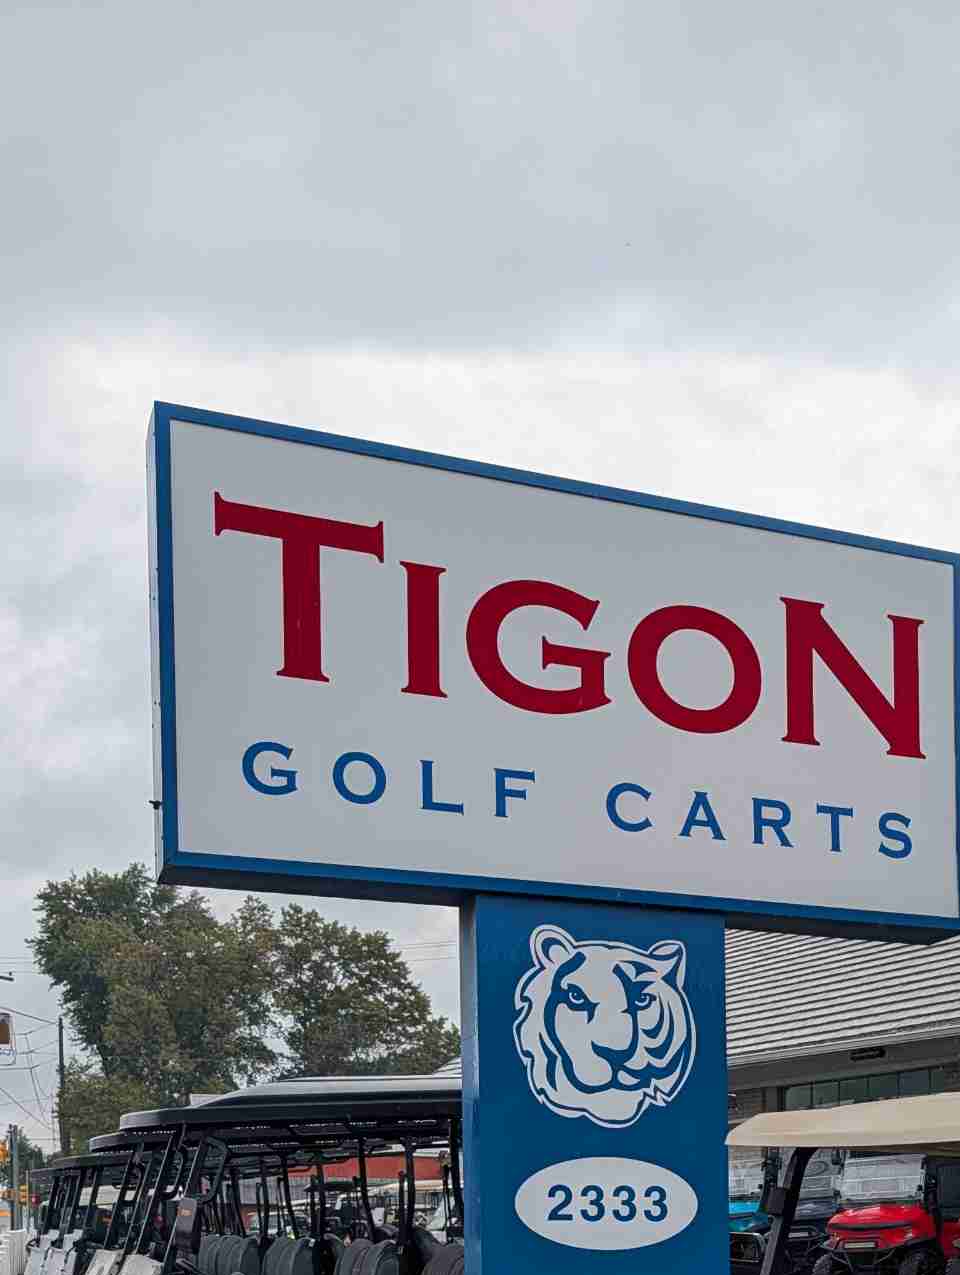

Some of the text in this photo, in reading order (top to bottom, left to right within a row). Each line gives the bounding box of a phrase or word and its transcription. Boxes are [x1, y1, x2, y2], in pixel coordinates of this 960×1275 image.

[213, 492, 925, 759] TIGON
[241, 741, 913, 859] GOLF CARTS
[547, 1184, 668, 1222] 2333
